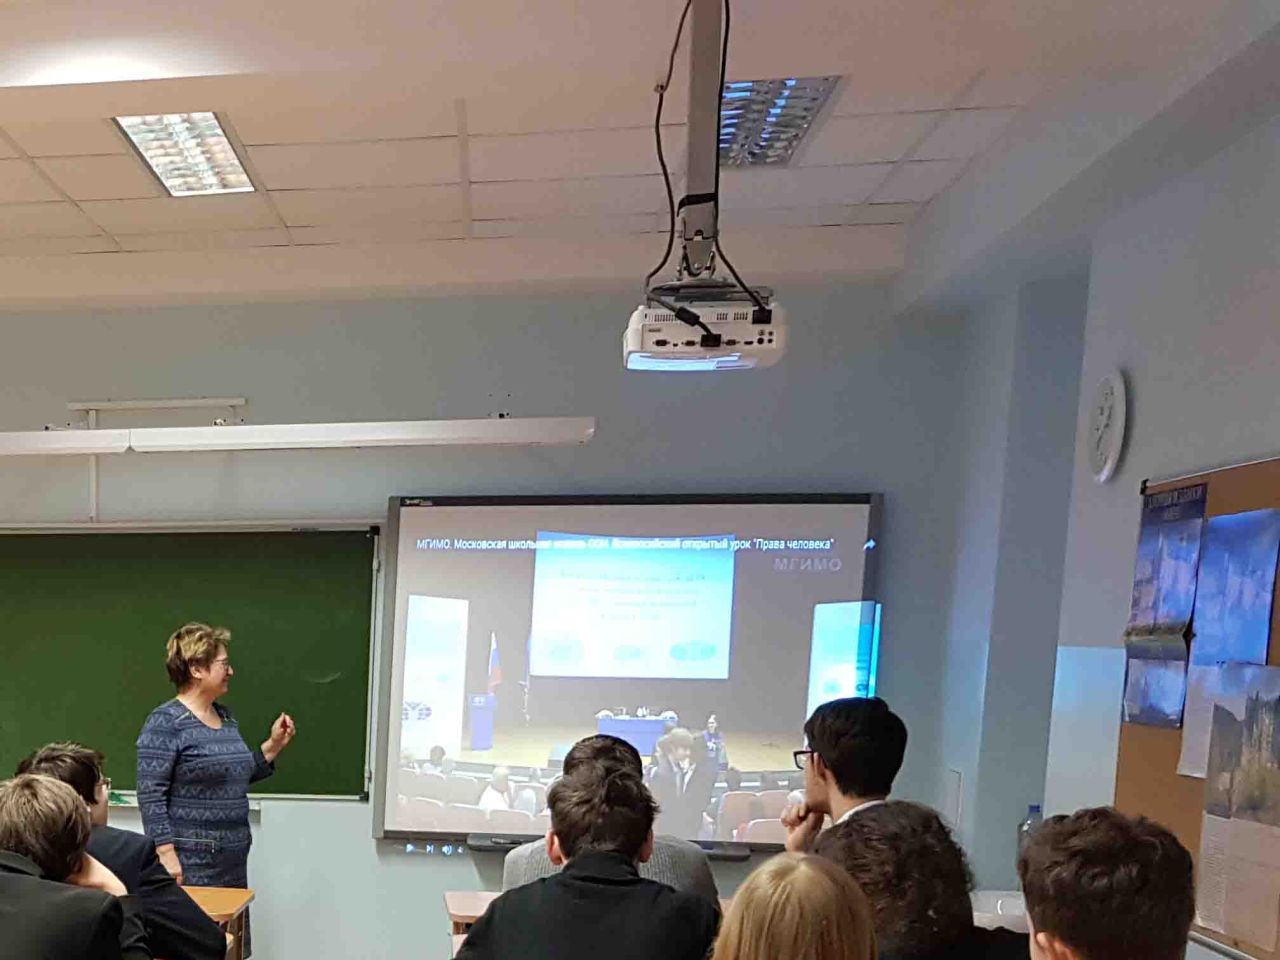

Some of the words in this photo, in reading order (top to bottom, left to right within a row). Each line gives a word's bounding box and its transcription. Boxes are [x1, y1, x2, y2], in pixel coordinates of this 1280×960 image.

[454, 538, 506, 550] Московская
[729, 539, 751, 552] урок
[773, 557, 843, 572] МГИМО
